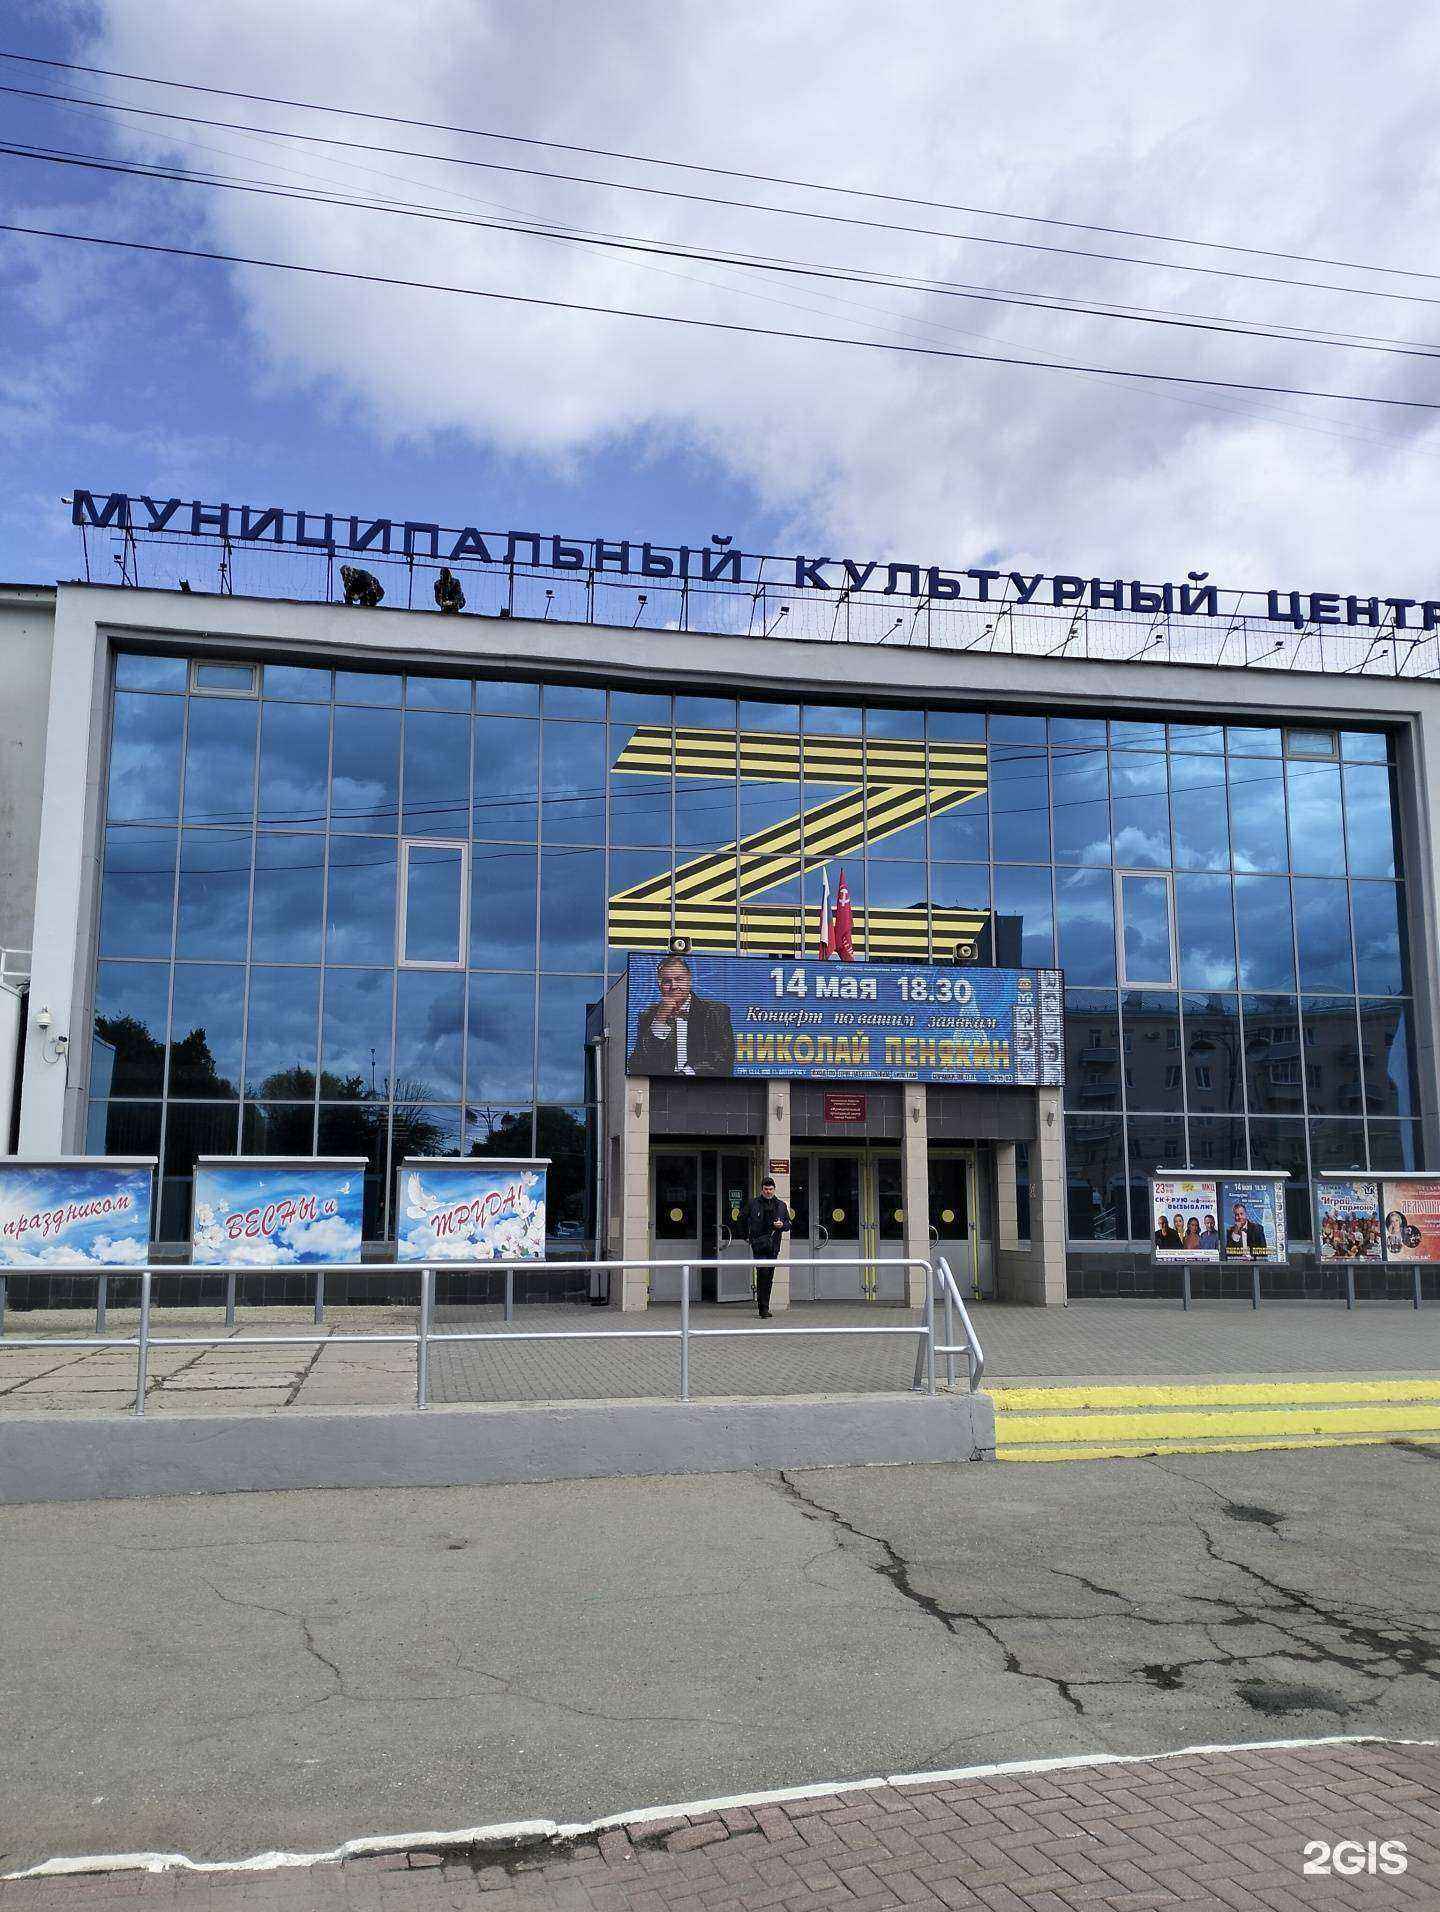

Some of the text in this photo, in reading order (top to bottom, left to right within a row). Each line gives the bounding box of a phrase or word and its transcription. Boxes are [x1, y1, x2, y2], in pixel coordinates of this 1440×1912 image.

[72, 489, 741, 583] МУНИЦИПАЛЬНЫЙ
[795, 555, 1218, 618] КУЛЬТУРНЫЙ
[769, 967, 973, 1003] 14 мая 18.30
[746, 1005, 824, 1027] Концерт
[833, 1012, 854, 1025] по
[857, 1013, 916, 1028] вашим
[736, 1029, 870, 1065] НИКОЛАЙ
[1155, 1183, 1166, 1194] 23
[4, 1196, 131, 1239] праздником
[225, 1196, 336, 1239] ВЕСНЫ и
[430, 1184, 523, 1237] ТРУДА!
